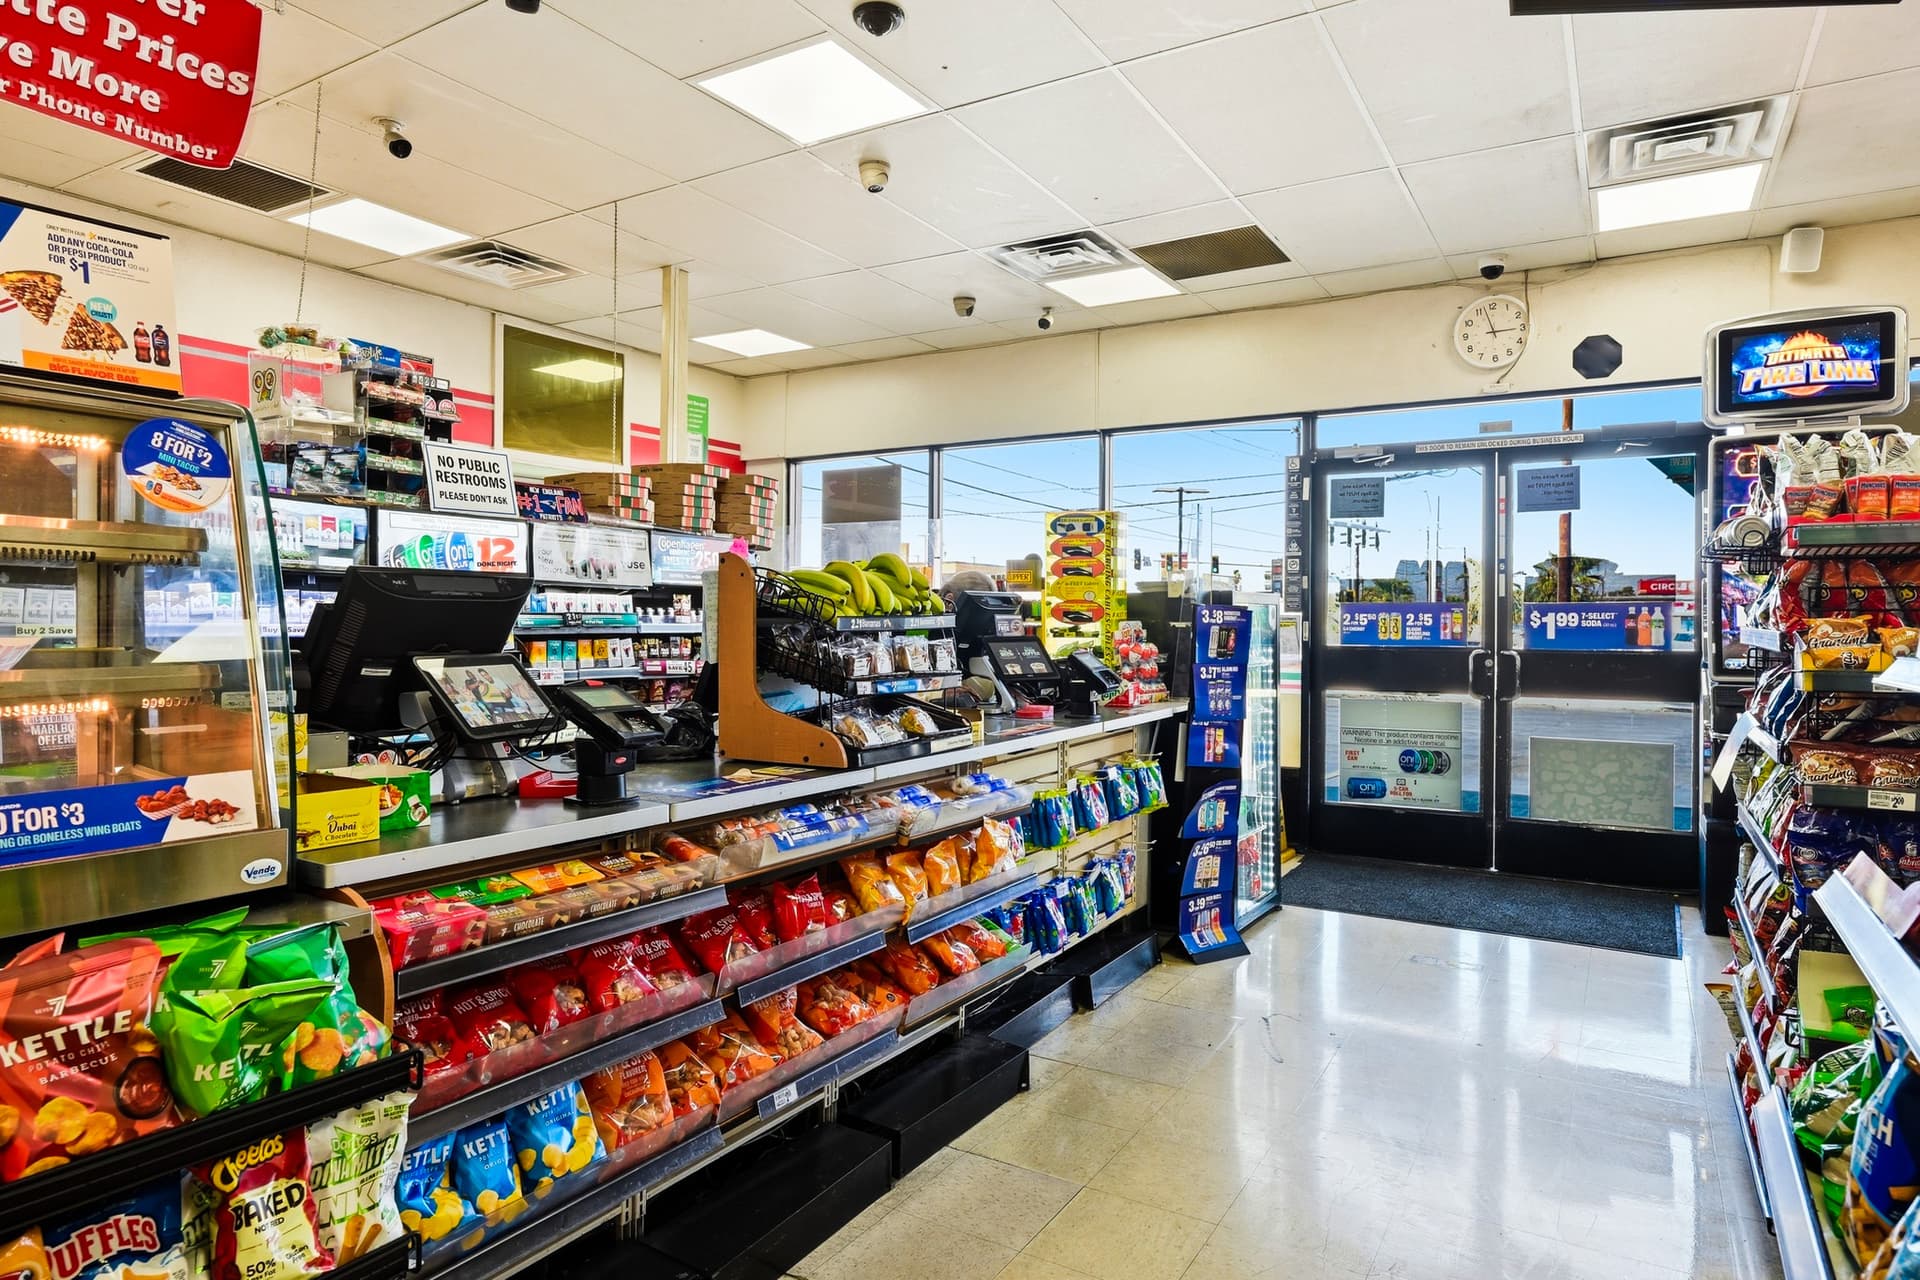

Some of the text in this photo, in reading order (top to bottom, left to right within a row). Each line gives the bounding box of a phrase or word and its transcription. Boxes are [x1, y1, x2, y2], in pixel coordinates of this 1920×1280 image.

[0, 0, 249, 96] tte Prices
[48, 47, 161, 113] More
[19, 80, 106, 126] Phone
[114, 113, 218, 161] Number
[47, 233, 66, 244] ADD
[67, 238, 85, 248] ANY
[97, 235, 139, 249] REWARDS
[48, 243, 127, 267] OR PEPSI PRODUCT
[48, 254, 66, 264] FOR
[69, 257, 90, 284] $1
[1476, 308, 1482, 316] 11
[1515, 311, 1522, 320] 2
[1464, 319, 1474, 328] 10
[1520, 323, 1526, 332] 3
[1462, 333, 1469, 341] 9
[1516, 337, 1523, 345] 4
[1467, 345, 1474, 353] 8
[1506, 349, 1513, 357] 5
[1767, 346, 1847, 366] ULTIMATE
[1478, 353, 1484, 361] 7
[1492, 354, 1499, 362] 6
[48, 362, 69, 374] BIG
[71, 367, 115, 381] FLAVOR
[117, 374, 140, 384] BAR
[1741, 360, 1874, 392] FIRE LINK
[150, 432, 164, 448] 8
[164, 436, 195, 461] FOR
[197, 448, 213, 467] $2
[1477, 440, 1508, 448] UNLOCKED
[158, 452, 200, 474] MINI TACOS
[437, 454, 500, 474] NO PUBLIC
[435, 470, 507, 490] RESTROOMS
[440, 490, 508, 505] PLEASE DON'T ASK
[555, 496, 585, 516] FAN
[477, 538, 515, 563] 12
[658, 536, 704, 551] Copenhagen
[1201, 609, 1209, 624] 3
[1343, 613, 1351, 625] 2
[1406, 614, 1414, 626] 2
[16, 626, 73, 636] Buy 2 Save
[1200, 667, 1207, 679] 3
[12, 802, 85, 833] FOR $3
[17, 835, 32, 847] OR
[33, 829, 83, 843] BONELESS
[85, 825, 111, 837] WING
[112, 820, 142, 833] BOATS
[328, 820, 357, 834] Dubai
[325, 831, 358, 841] Chocolate
[244, 866, 276, 879] Vendo
[590, 900, 617, 913] CHOCOLATE
[514, 917, 544, 930] CHOCOLATE
[651, 939, 672, 951] SPICY
[402, 998, 437, 1016] SPICY
[454, 987, 512, 1015] HOT & SPICY
[479, 999, 504, 1012] FLAVORED
[0, 1009, 132, 1068] KETTLE
[28, 1052, 75, 1073] POTATO
[39, 1052, 119, 1085] BARBECUE
[463, 1129, 510, 1159] KETT
[210, 1134, 285, 1192] Cheetos
[230, 1182, 306, 1232] BAKED
[246, 1259, 277, 1277] 50%
